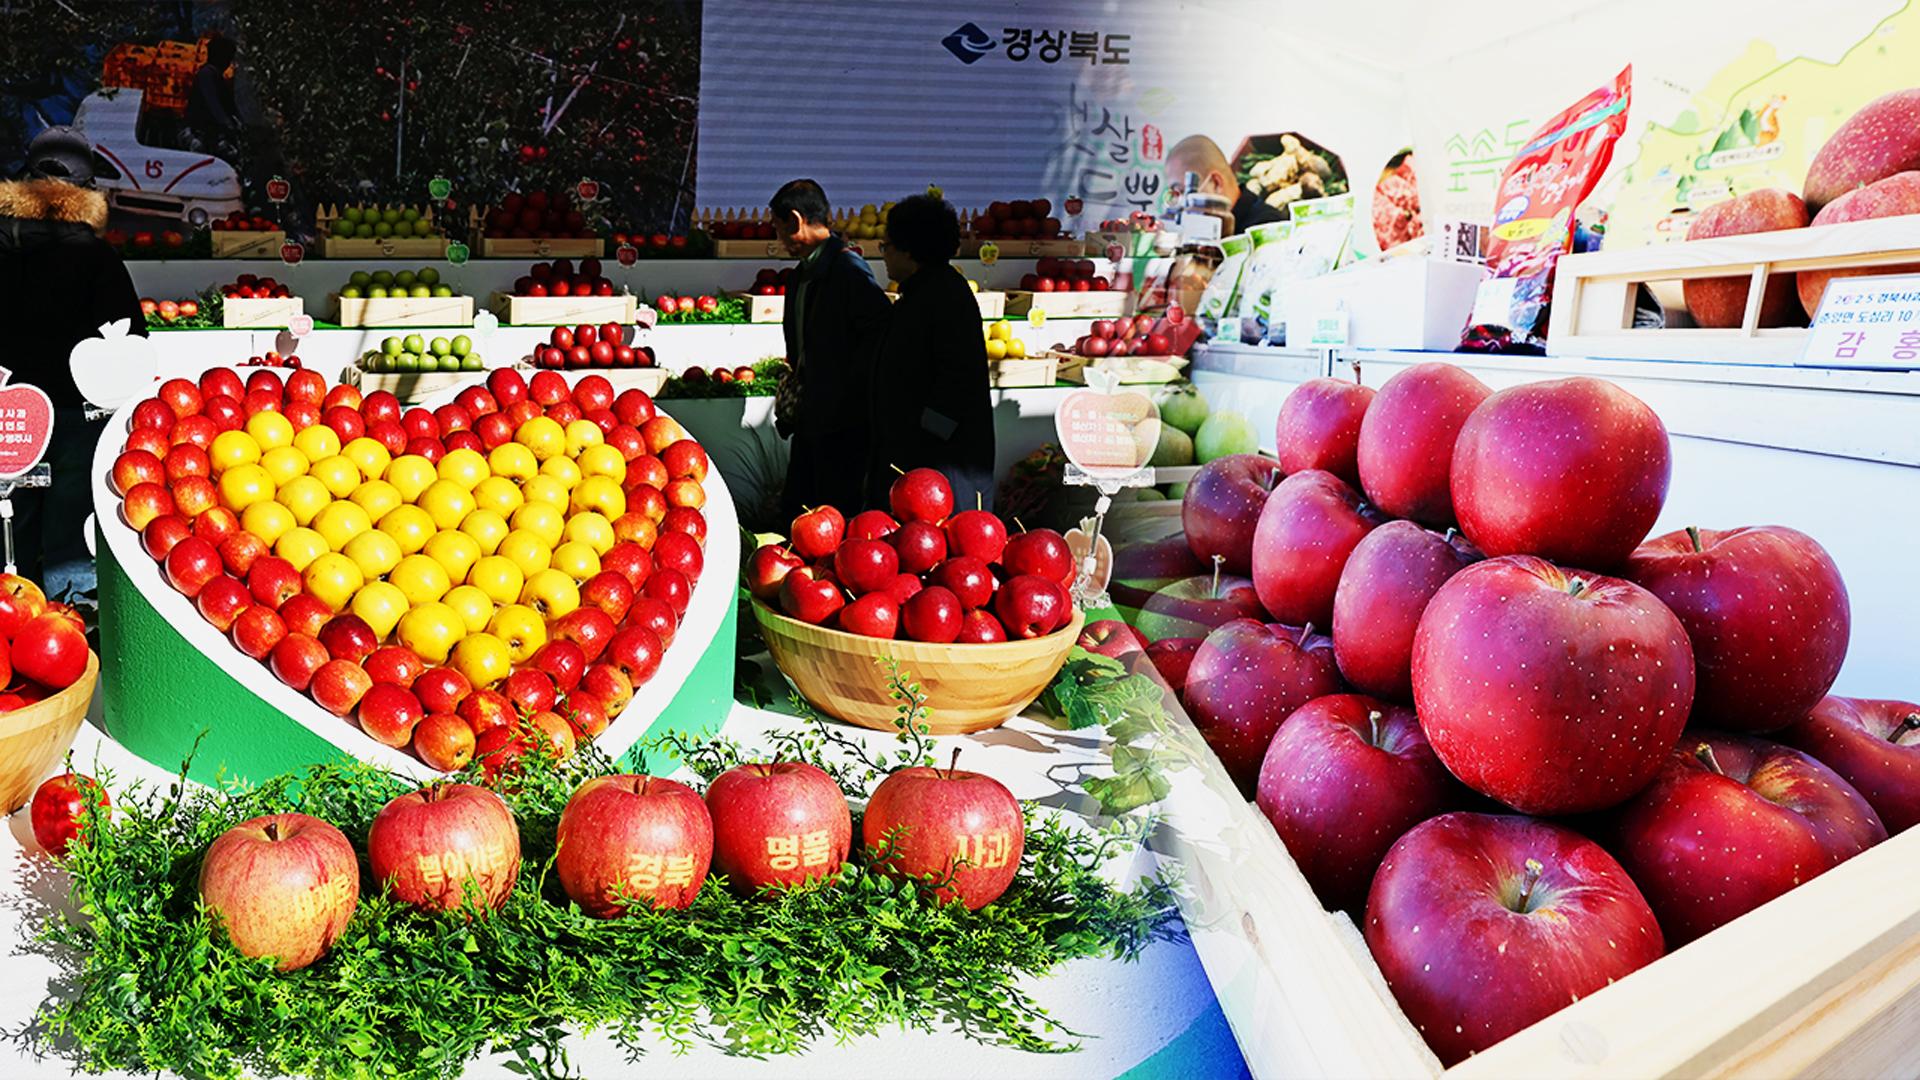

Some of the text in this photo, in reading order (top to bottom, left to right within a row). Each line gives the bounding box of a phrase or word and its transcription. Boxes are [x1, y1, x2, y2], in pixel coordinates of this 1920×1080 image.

[1003, 28, 1131, 65] 경상북도
[766, 829, 830, 871] 명품
[953, 831, 1011, 869] 사과
[629, 853, 694, 889] 경북
